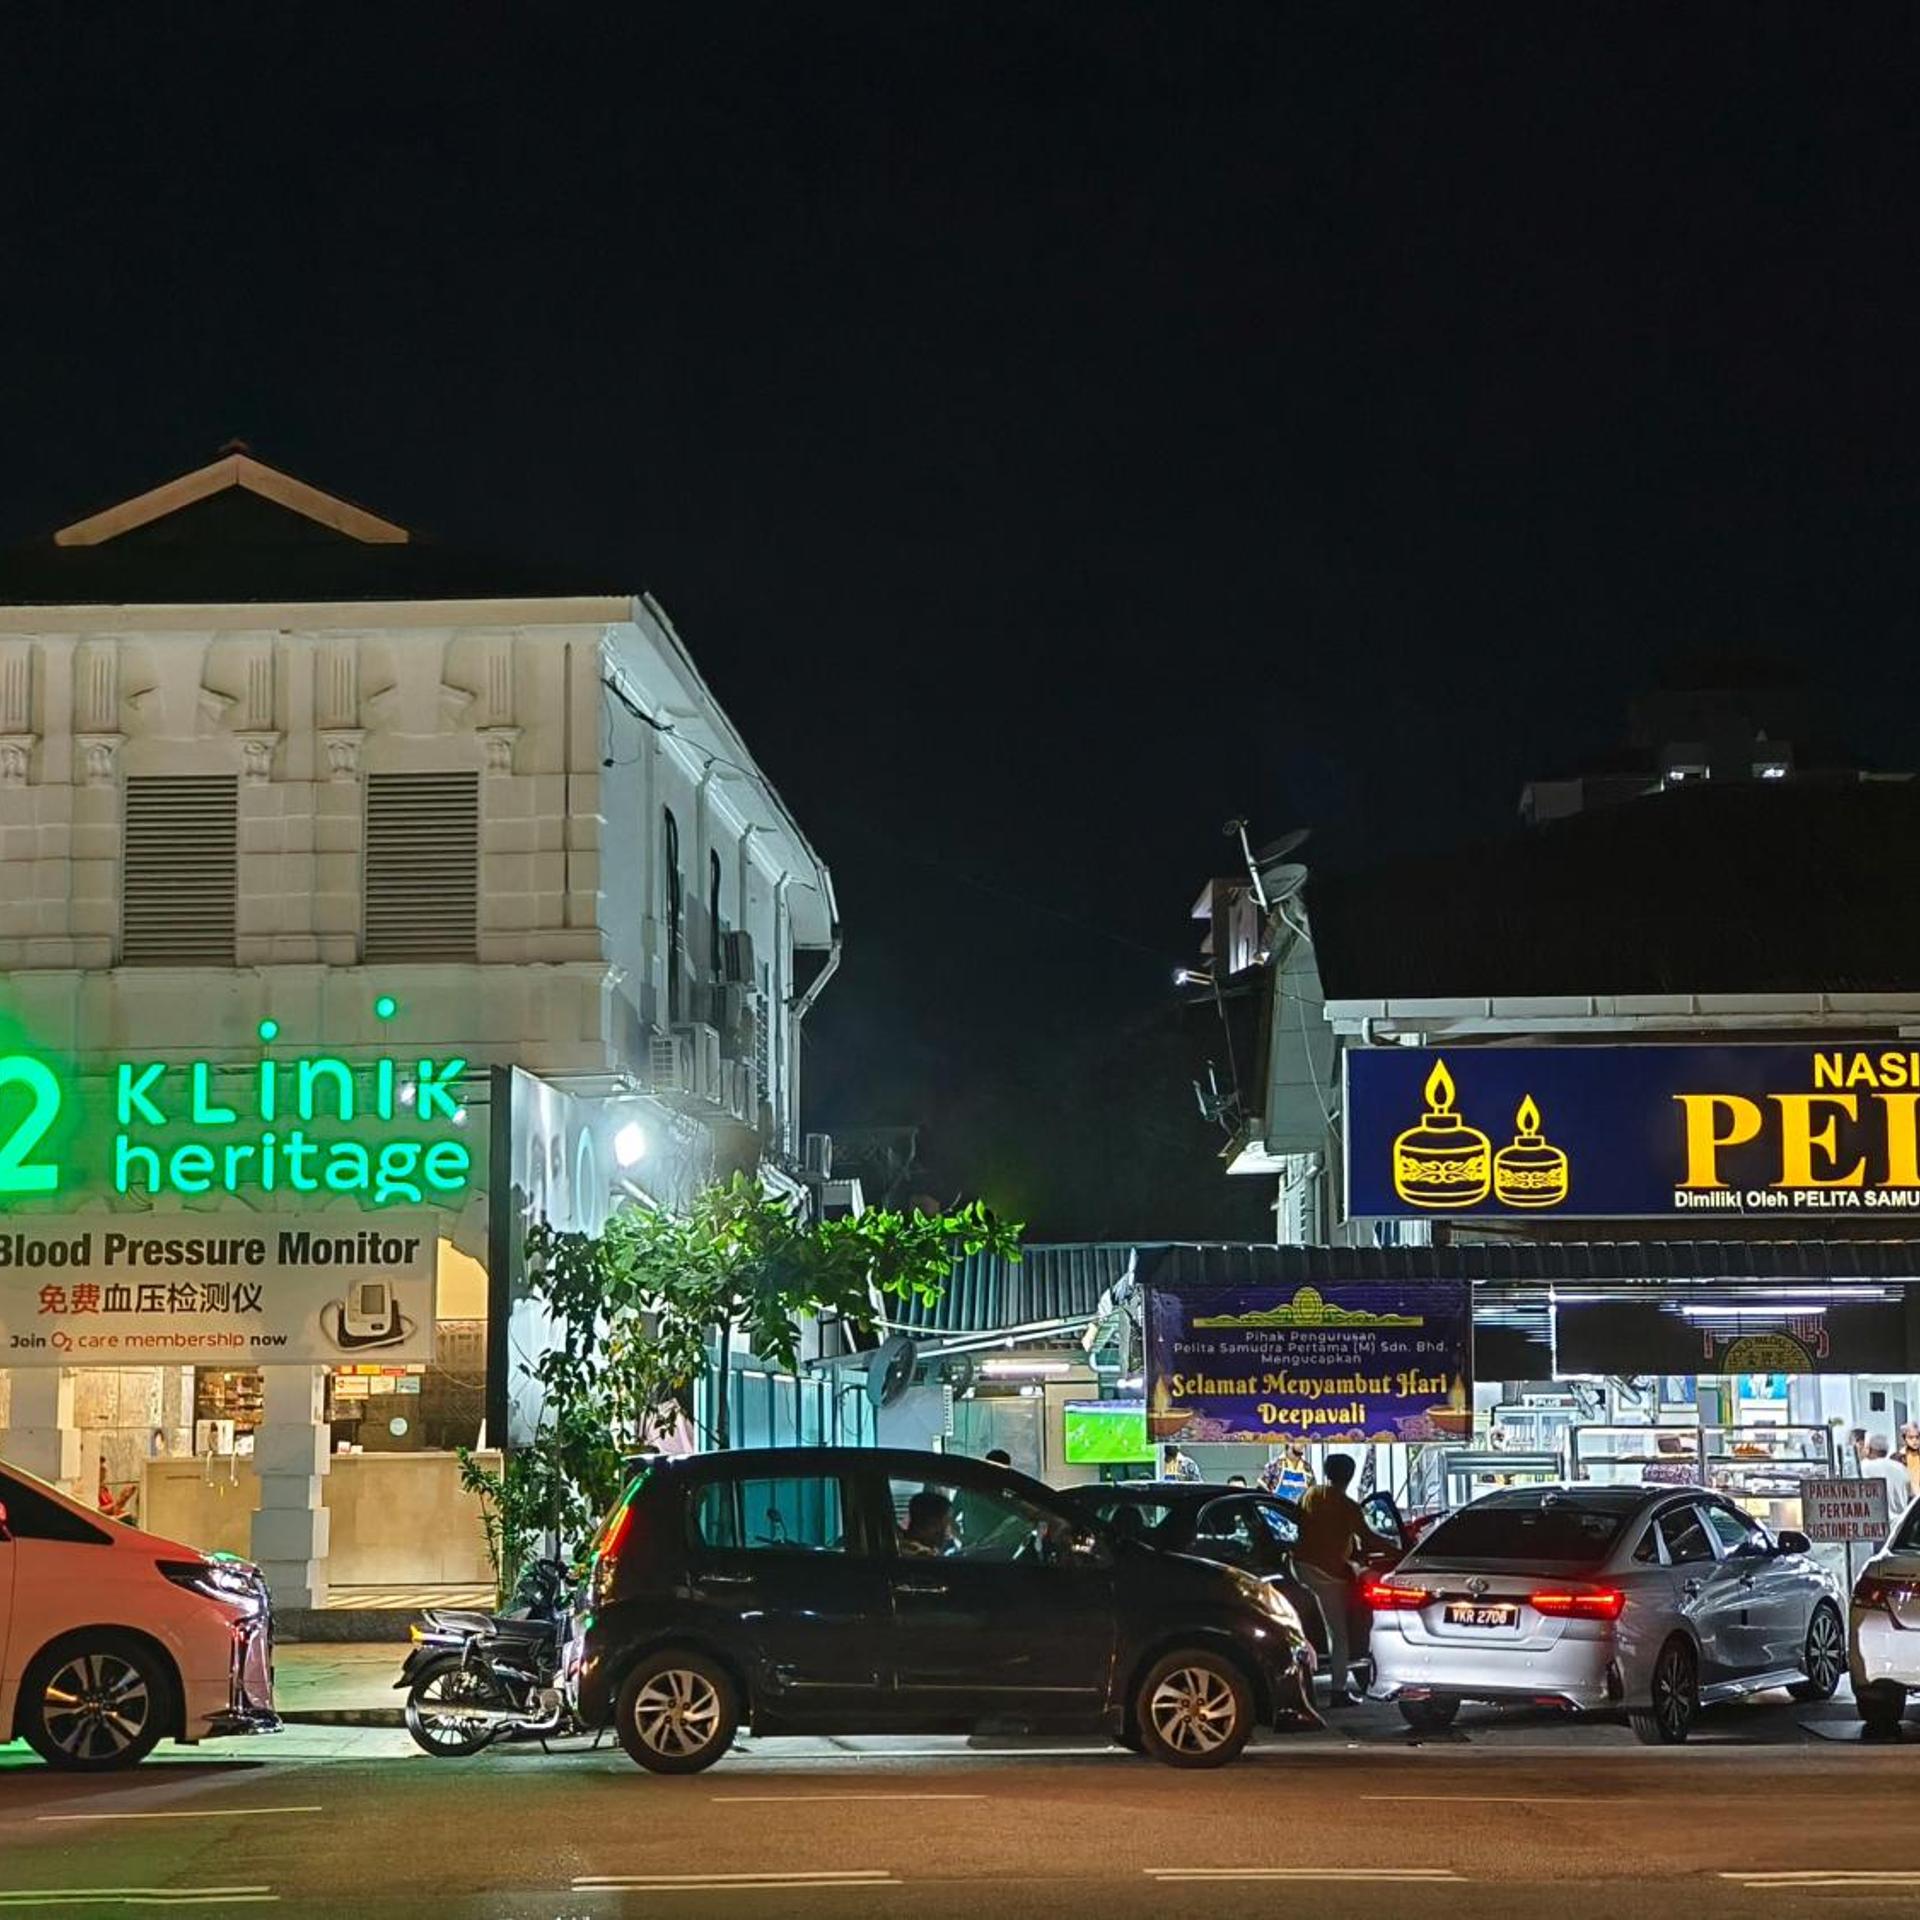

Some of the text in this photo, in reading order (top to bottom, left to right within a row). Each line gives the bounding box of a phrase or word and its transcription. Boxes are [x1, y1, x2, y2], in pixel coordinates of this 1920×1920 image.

[1814, 1052, 1920, 1088] NASI
[116, 1132, 470, 1202] heritage
[1674, 1190, 1920, 1207] Dimiliki Oleh PELITA SAMU
[104, 1233, 265, 1266] Pressure
[278, 1231, 420, 1265] Monitor
[38, 1282, 263, 1315] 免费血压检测仪
[10, 1333, 46, 1349] Join
[78, 1335, 119, 1348] care
[125, 1331, 244, 1349] membership
[250, 1334, 288, 1347] now
[1246, 1331, 1376, 1344] Pihak Pengurusan
[1174, 1342, 1215, 1353] Pelita
[1220, 1342, 1282, 1353] Samudra
[1288, 1342, 1348, 1353] Pertama
[1380, 1341, 1412, 1352] Sdn.
[1416, 1341, 1449, 1352] Bhd.
[1261, 1354, 1362, 1366] Mengucapkan
[1172, 1368, 1448, 1400] Selamat Menyambut Hari
[1257, 1402, 1366, 1430] Deepavali
[1809, 1483, 1857, 1499] PARKING
[1818, 1502, 1871, 1518] PERTAMA
[1805, 1521, 1859, 1539] CUSTOMER
